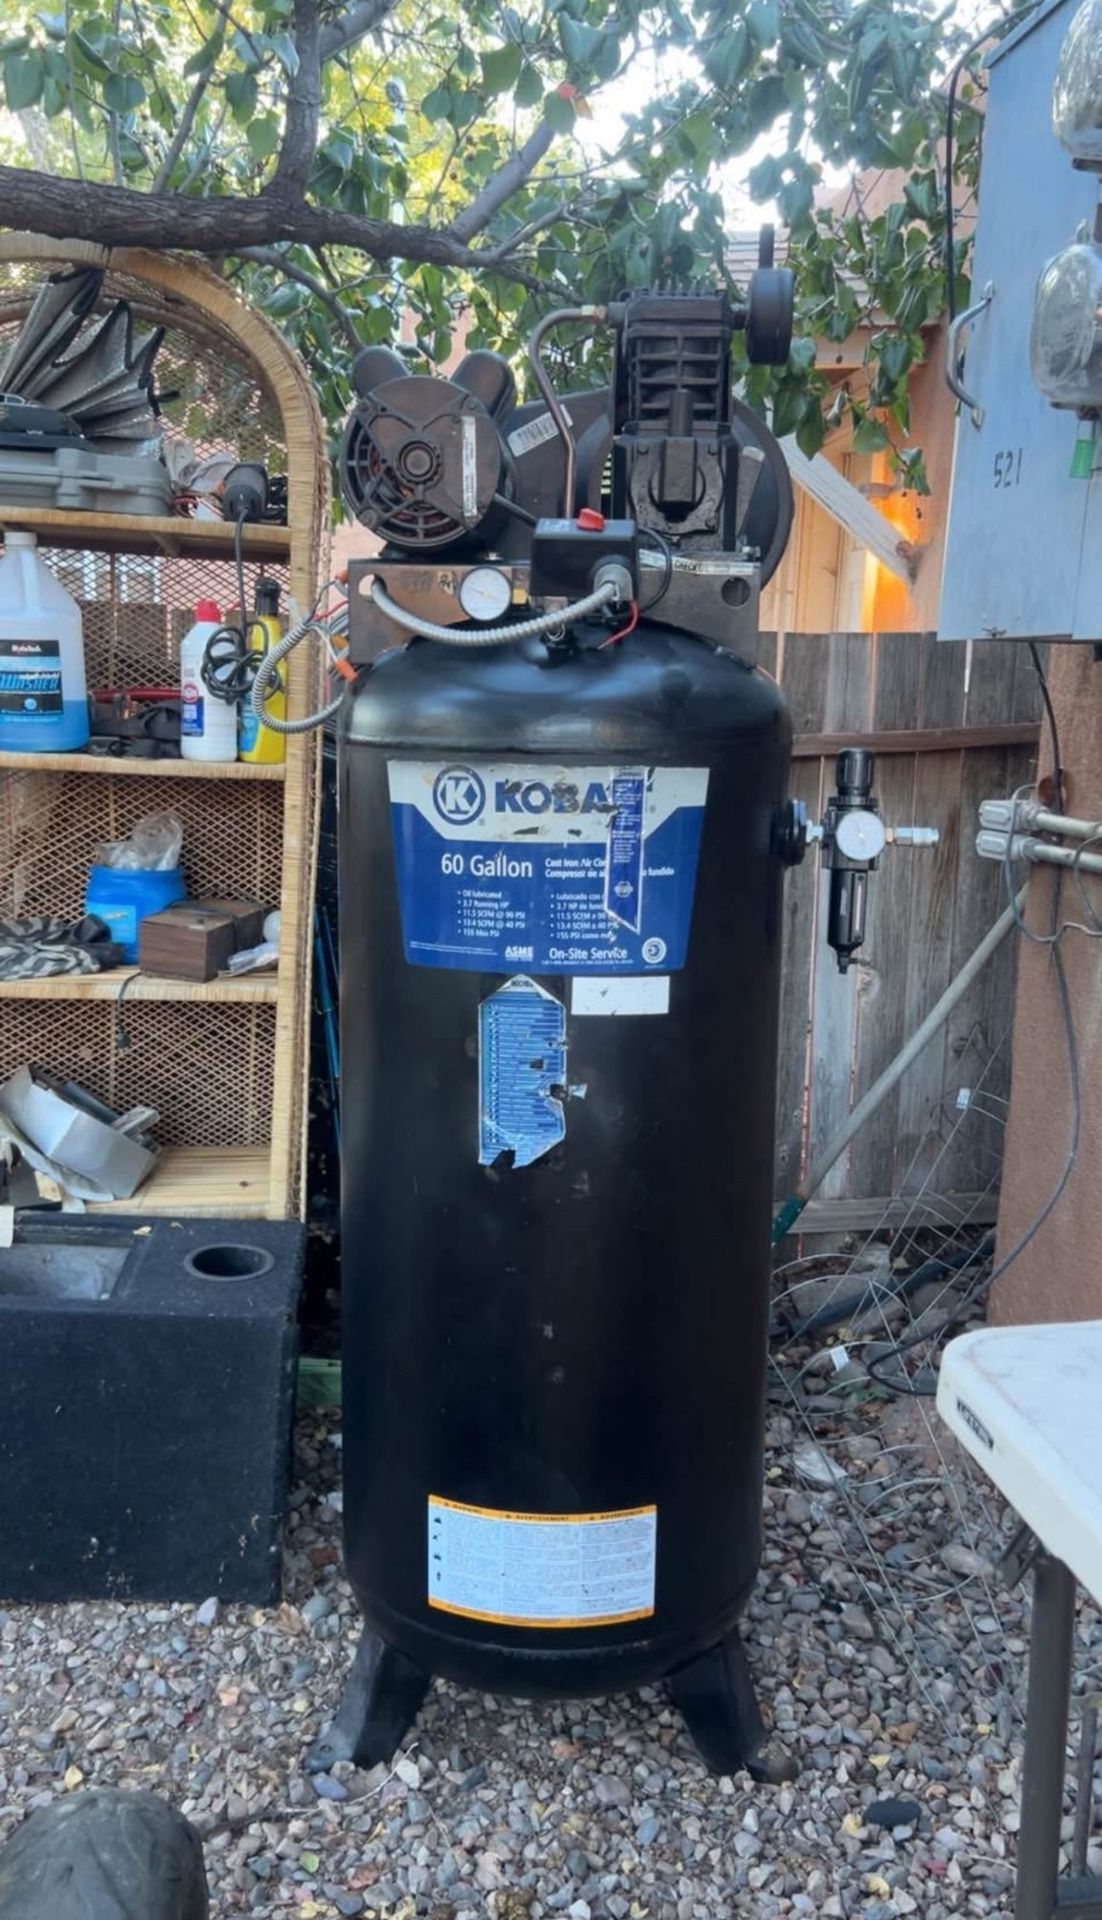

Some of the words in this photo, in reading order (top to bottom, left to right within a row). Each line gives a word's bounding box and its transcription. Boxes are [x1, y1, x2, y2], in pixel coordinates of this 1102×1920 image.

[993, 447, 1023, 488] 521
[495, 780, 610, 814] KOBA
[441, 853, 464, 875] 60
[470, 854, 533, 878] Gallon
[544, 857, 562, 868] Cast
[563, 858, 579, 868] Iron
[580, 858, 592, 868] Air
[544, 868, 586, 880] Compresor
[587, 868, 598, 878] de
[495, 910, 504, 919] @
[515, 911, 526, 920] PSI
[495, 920, 504, 929] @
[515, 921, 526, 929] PSI
[505, 945, 534, 958] ASME
[549, 947, 588, 959] On-Site
[591, 947, 628, 959] Service
